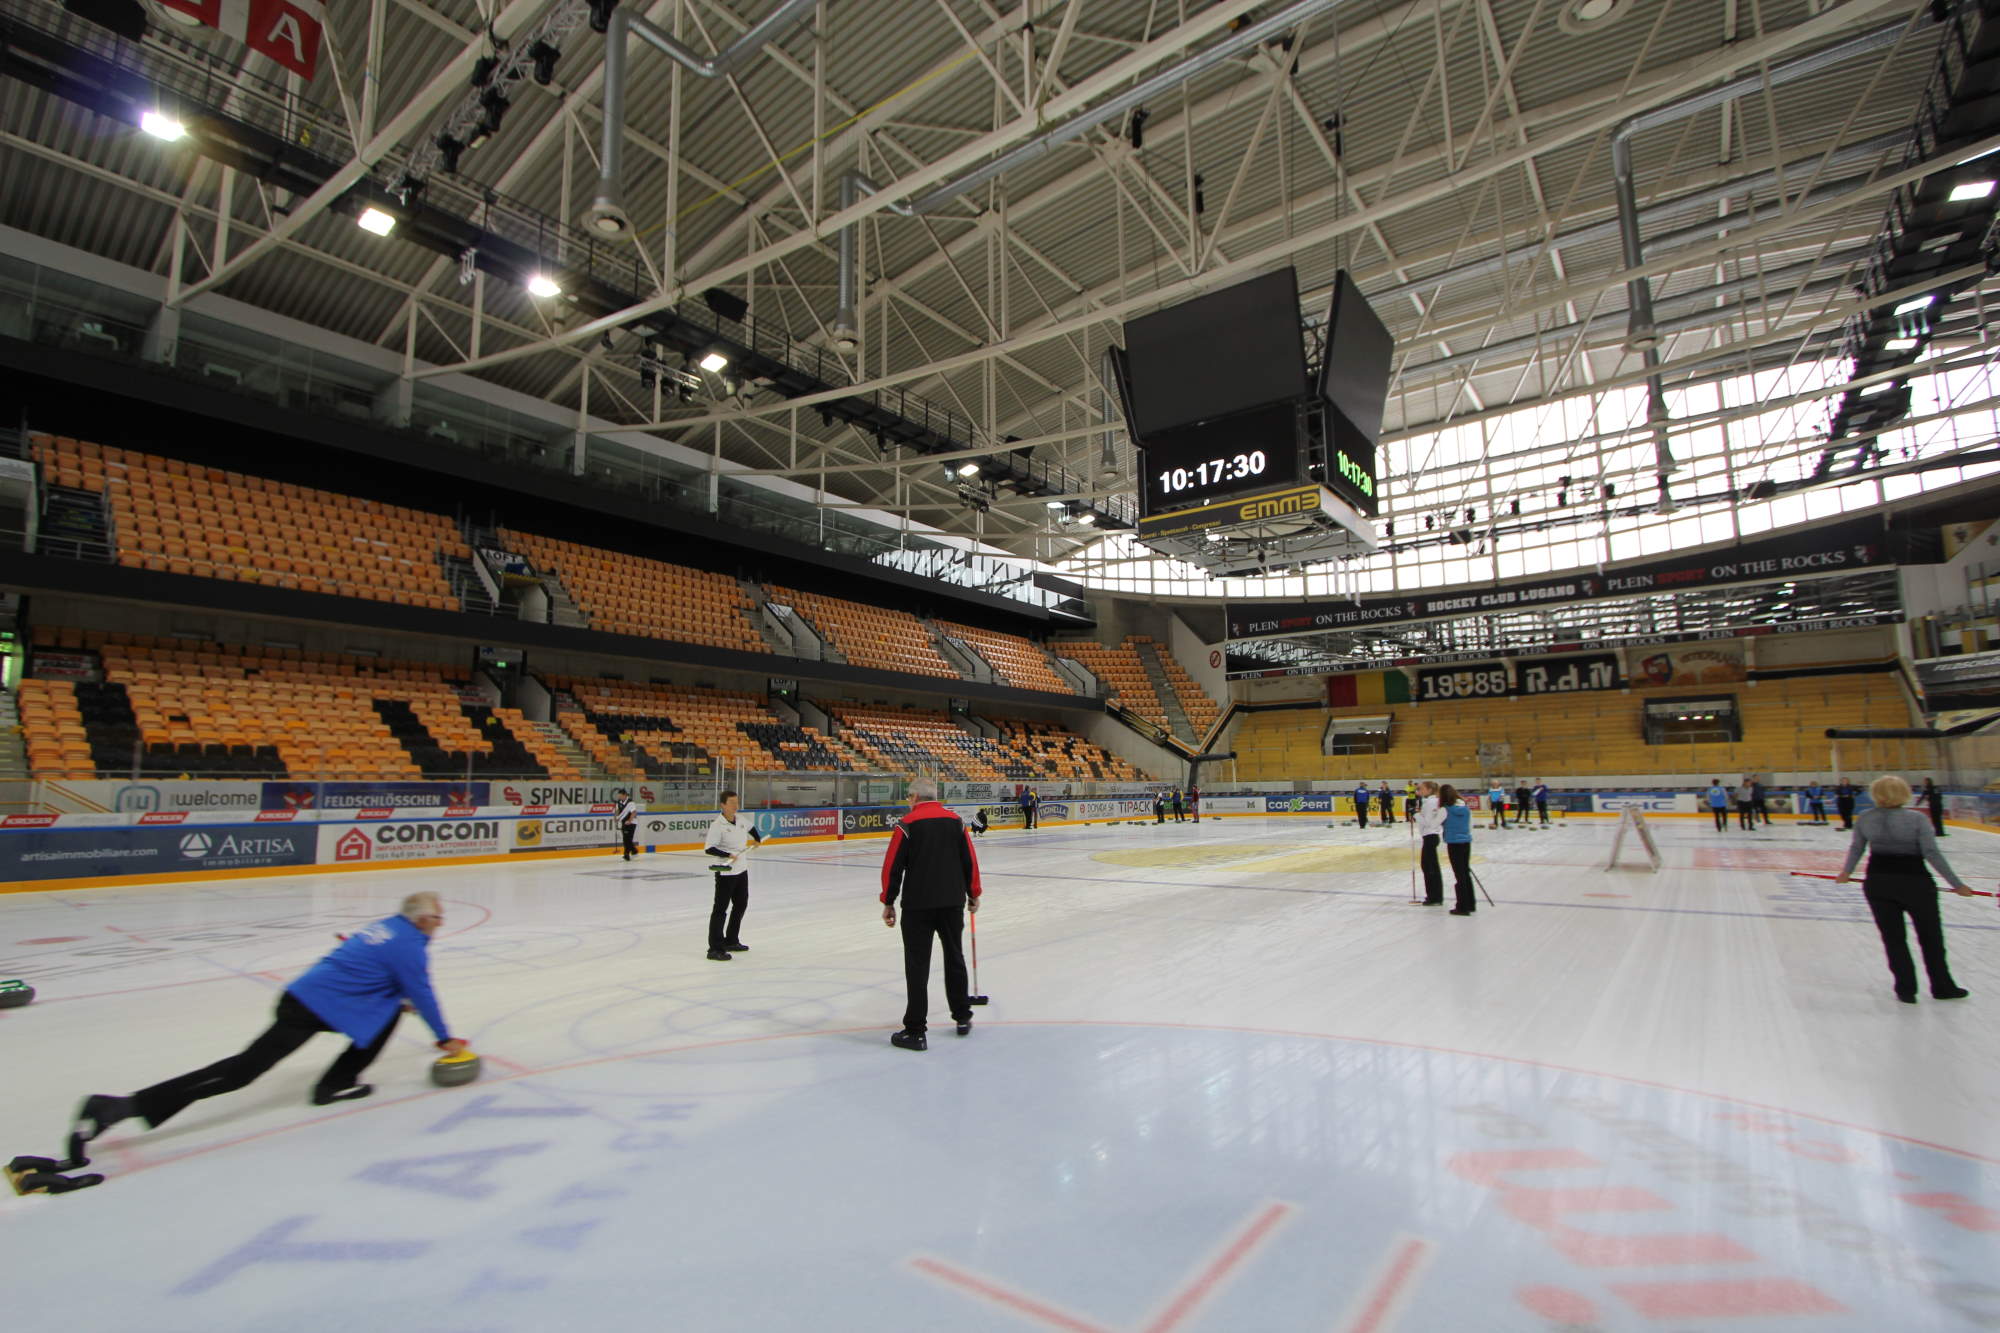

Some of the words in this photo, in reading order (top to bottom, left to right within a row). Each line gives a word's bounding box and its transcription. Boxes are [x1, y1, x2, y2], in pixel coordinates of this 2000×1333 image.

[1160, 451, 1265, 493] 10:17:30
[1337, 450, 1373, 497] 10:17:30
[1608, 575, 1653, 590] PLEIN
[1712, 565, 1738, 578] ON
[1742, 559, 1776, 574] THE
[1781, 551, 1846, 570] ROCKS
[1427, 597, 1477, 612] HOCKEY
[1481, 592, 1516, 606] CLUB
[1520, 584, 1575, 600] LUGANO
[1249, 621, 1279, 632] PLEIN
[1316, 615, 1332, 625] ON
[1334, 612, 1358, 623] THE
[1361, 606, 1401, 619] ROCKS
[1777, 623, 1793, 633] ON
[1795, 621, 1820, 632] THE
[1822, 617, 1878, 629] ROCKS
[1287, 668, 1299, 676] ON
[1301, 667, 1316, 675] THE
[1317, 664, 1344, 673] ROCKS
[172, 790, 258, 808] welcome
[324, 793, 441, 807] FELDSCHLÖSSCHEN
[1118, 801, 1150, 813] TIPACK
[779, 815, 836, 827] ticino.com
[859, 816, 883, 828] OPEL
[377, 822, 499, 843] conconi
[217, 834, 295, 855] ARTISA
[21, 848, 158, 861] artisaimmobiliare.com
